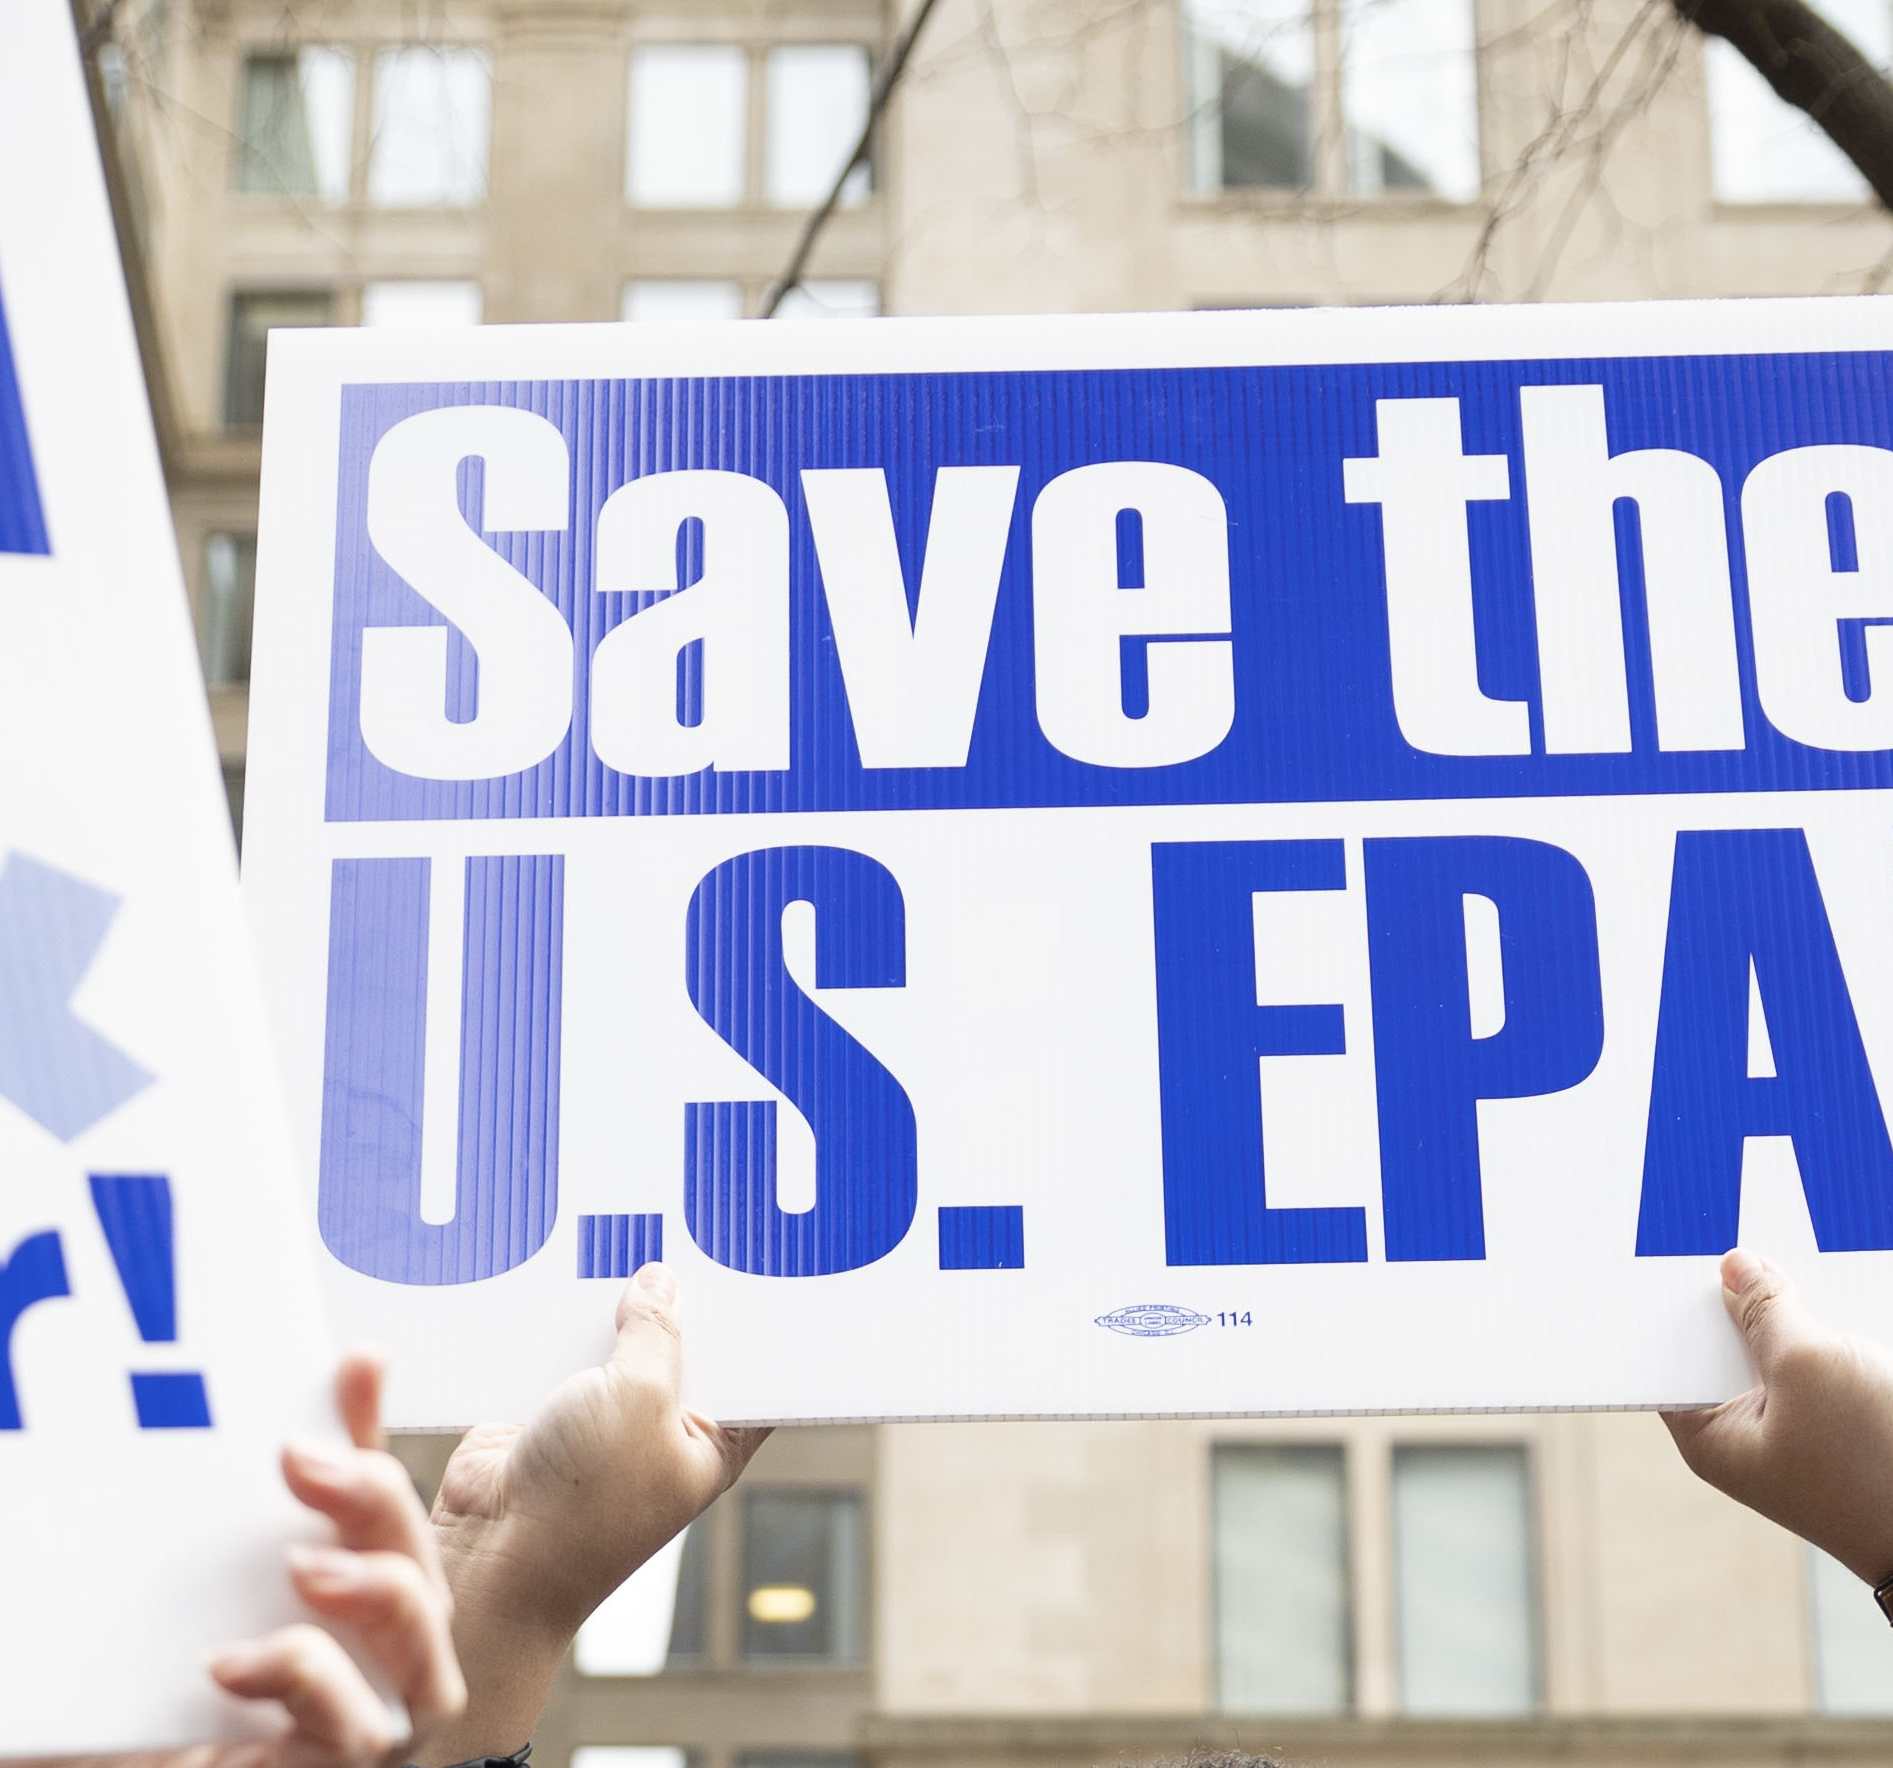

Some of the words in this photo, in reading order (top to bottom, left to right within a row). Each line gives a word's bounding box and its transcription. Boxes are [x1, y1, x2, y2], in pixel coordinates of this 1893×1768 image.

[357, 403, 1237, 782] Save
[318, 845, 1026, 1286] U.S.
[1217, 1311, 1253, 1327] 114
